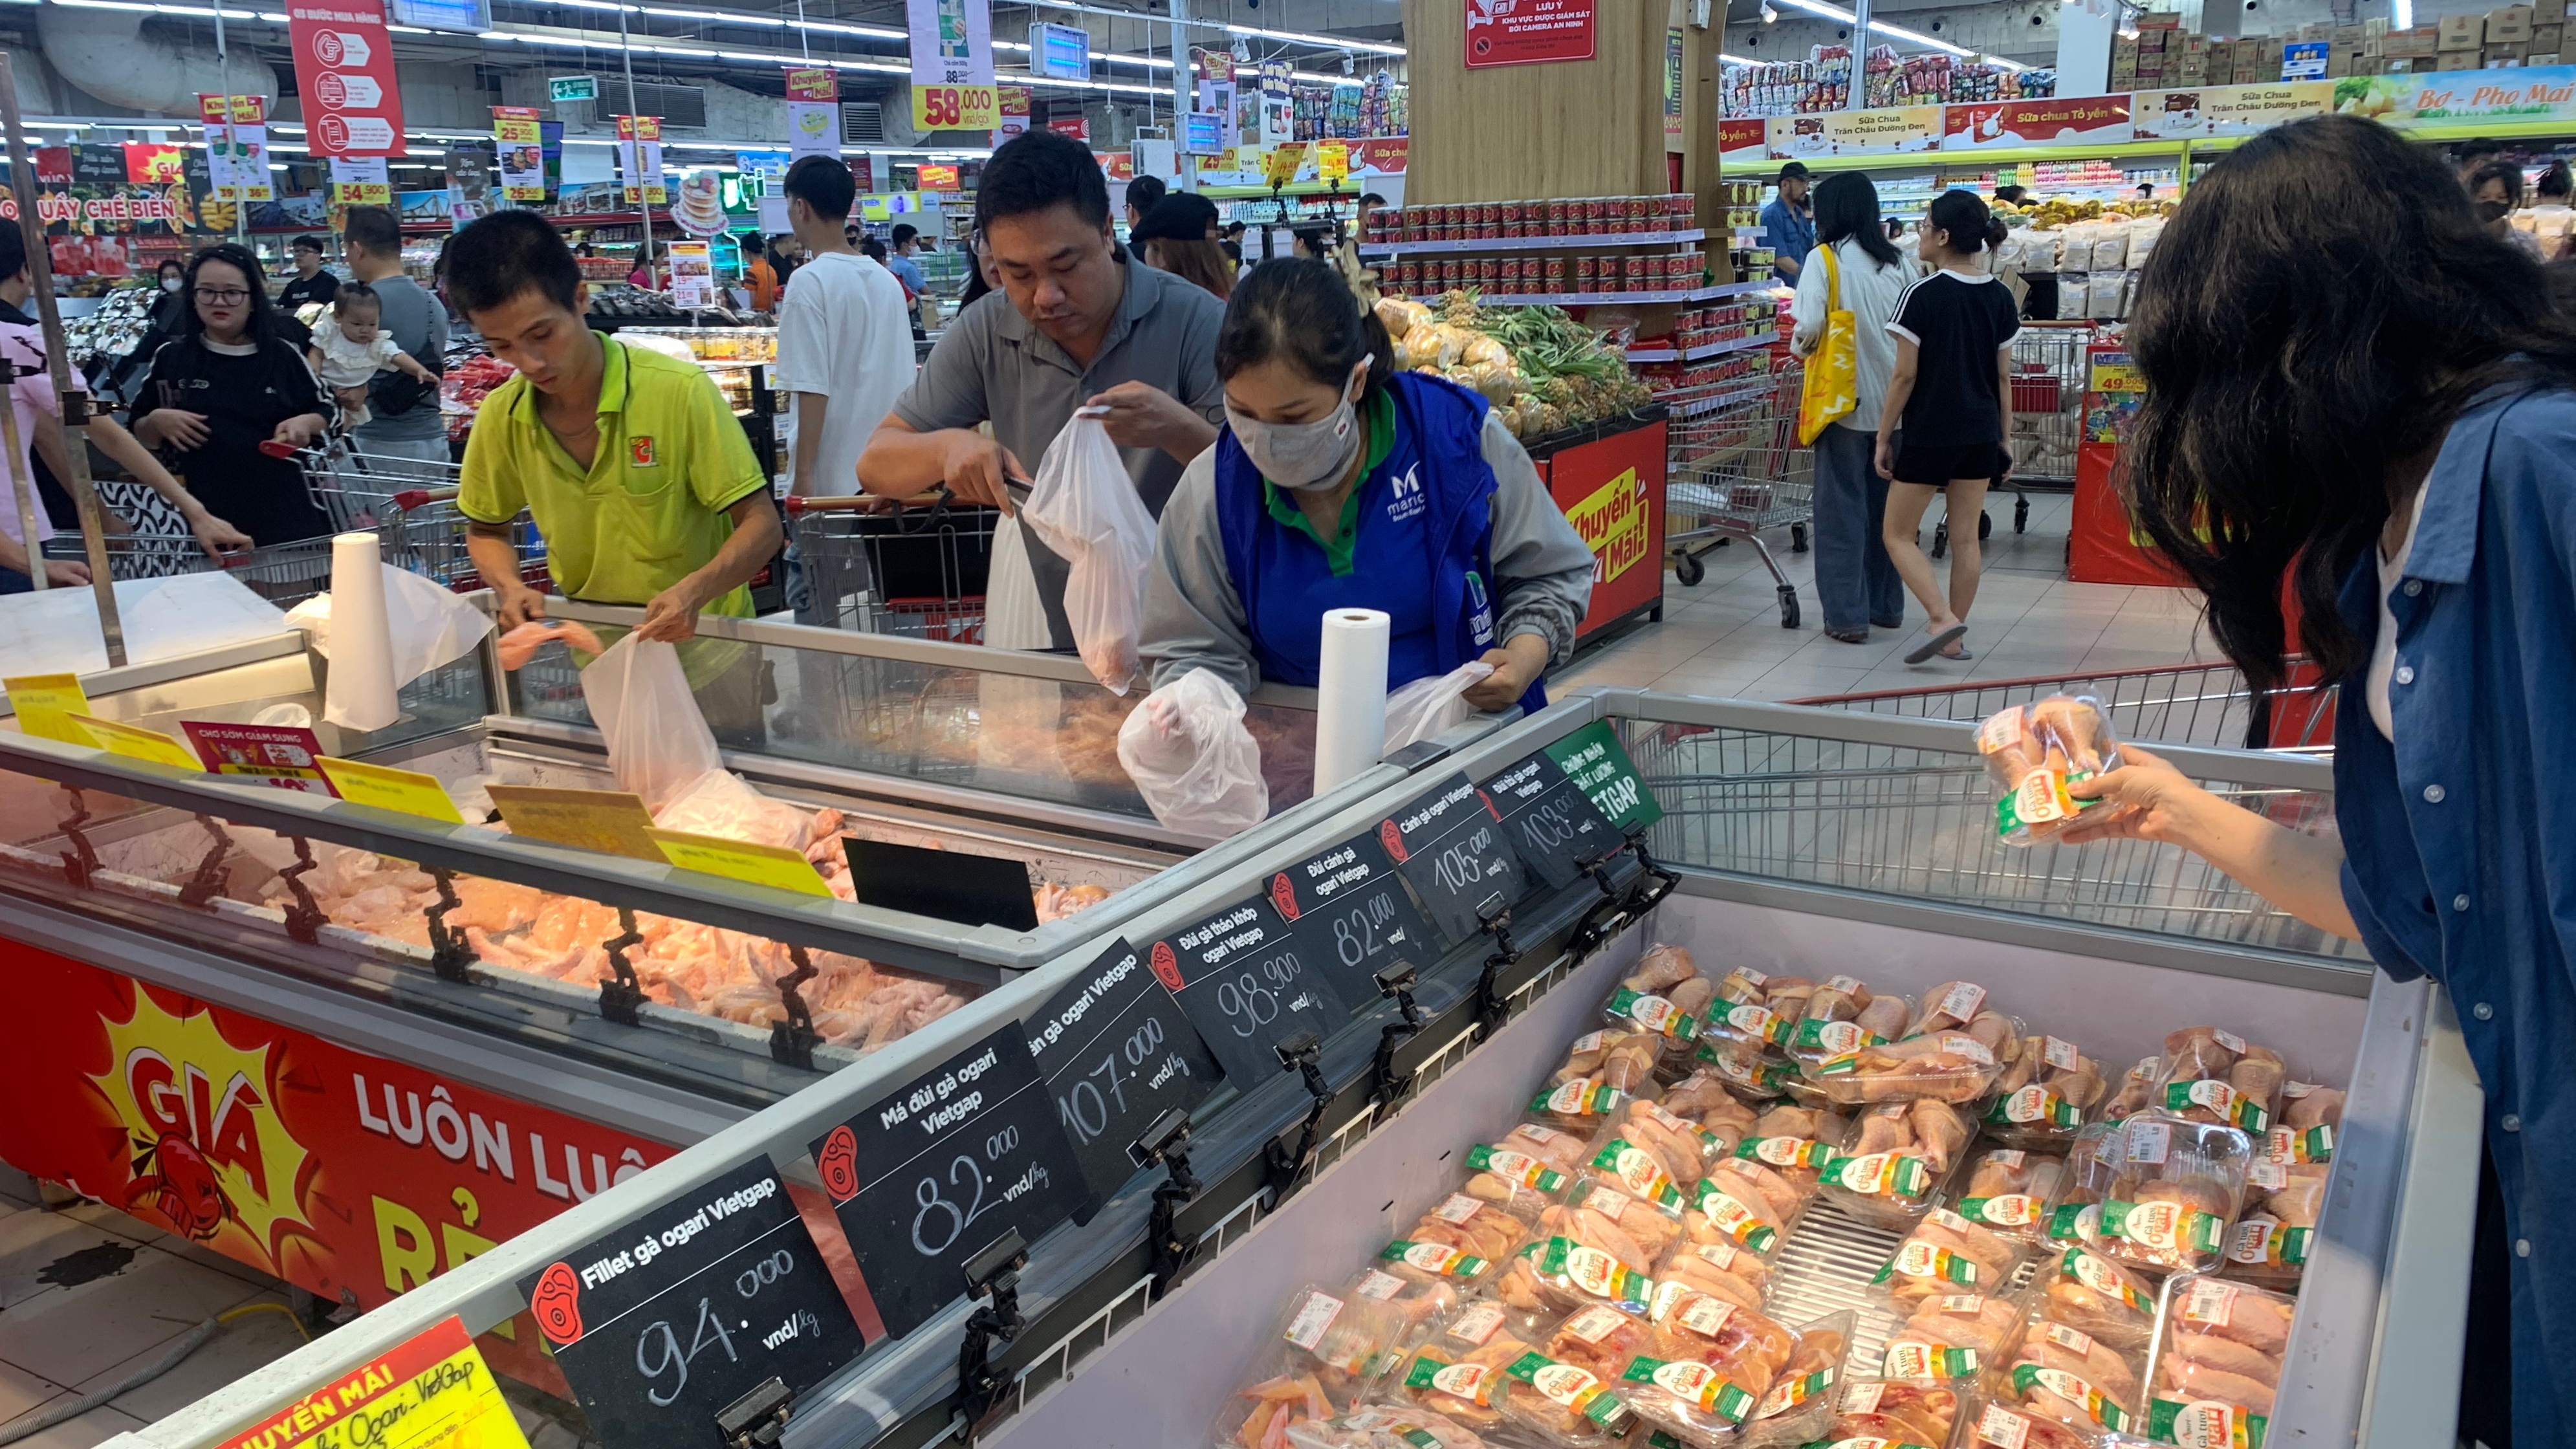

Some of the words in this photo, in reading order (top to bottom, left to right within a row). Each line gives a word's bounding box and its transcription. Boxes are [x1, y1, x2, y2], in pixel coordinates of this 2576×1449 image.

[334, 11, 355, 22] MUA
[355, 12, 381, 25] HÀNG
[1509, 25, 1522, 33] BỞI
[1522, 23, 1553, 32] CAMERA
[1518, 14, 1533, 23] VỰC
[1534, 13, 1555, 22] ĐƯỢC
[1556, 11, 1575, 19] GIÁM
[1575, 10, 1591, 18] SÁT
[792, 72, 822, 85] Khuyến
[816, 82, 833, 97] Mãi!
[206, 96, 245, 111] Khuến
[924, 89, 991, 125] 58.000
[2236, 102, 2261, 111] Châu
[2264, 100, 2297, 110] Đường
[2242, 92, 2261, 100] Sữa
[2264, 91, 2292, 100] Chua
[2417, 89, 2453, 109] Bơ
[2471, 86, 2520, 105] Pho
[2524, 82, 2576, 104] Mai
[1855, 125, 1876, 135] Châu
[1878, 123, 1907, 134] Đường
[1908, 122, 1926, 130] Đen
[1859, 116, 1875, 125] Sữa
[1877, 114, 1901, 124] Chua
[2017, 110, 2040, 123] Sữa
[2040, 111, 2069, 122] chua
[2071, 107, 2084, 120] Tổ
[2086, 107, 2108, 122] yến
[1728, 129, 1747, 142] yến
[1375, 148, 1390, 158] Sữa
[1392, 148, 1408, 157] chu
[39, 191, 80, 219] UẦY
[86, 191, 126, 219] CHẾ
[131, 191, 175, 219] BIẾN
[342, 185, 385, 202] 54.900
[1387, 492, 1426, 516] maric
[1610, 501, 1646, 576] Mãi!
[198, 729, 220, 739] CHỢ
[221, 729, 245, 739] SỚM
[272, 734, 302, 743] SUNG
[1399, 815, 1423, 834] Cánh
[1419, 807, 1433, 825] gà
[1429, 796, 1450, 816] ogari
[1444, 782, 1475, 805] Vietgap
[1307, 860, 1326, 878] Đùi
[1323, 852, 1346, 871] cánh
[1343, 845, 1357, 864] gà
[1315, 875, 1340, 896] ogari
[1335, 863, 1370, 885] Vietgap
[1178, 932, 1201, 951] Đùi
[1198, 926, 1215, 945] gà
[1209, 917, 1235, 936] tháo
[1230, 907, 1258, 926] khớp
[1202, 941, 1230, 964] ogari
[1228, 926, 1264, 951] Vietgap
[1043, 1019, 1065, 1045] gà
[1061, 990, 1095, 1026] ogari
[1088, 953, 1138, 997] Vietgap
[880, 1100, 909, 1131] Má
[908, 1084, 937, 1114] đùi
[935, 1072, 958, 1101] gà
[957, 1047, 999, 1082] ogari
[919, 1090, 983, 1135] Vietgap
[353, 1073, 516, 1182] LUÔN
[580, 1249, 635, 1291] Fillet
[633, 1234, 663, 1267] gà
[661, 1207, 711, 1247] ogari
[706, 1177, 777, 1222] Vietgap
[2148, 1205, 2174, 1245] Ogari
[2240, 1225, 2267, 1261] Ogari
[241, 1386, 337, 1449] HUYẾN
[337, 1362, 397, 1409] MÃI
